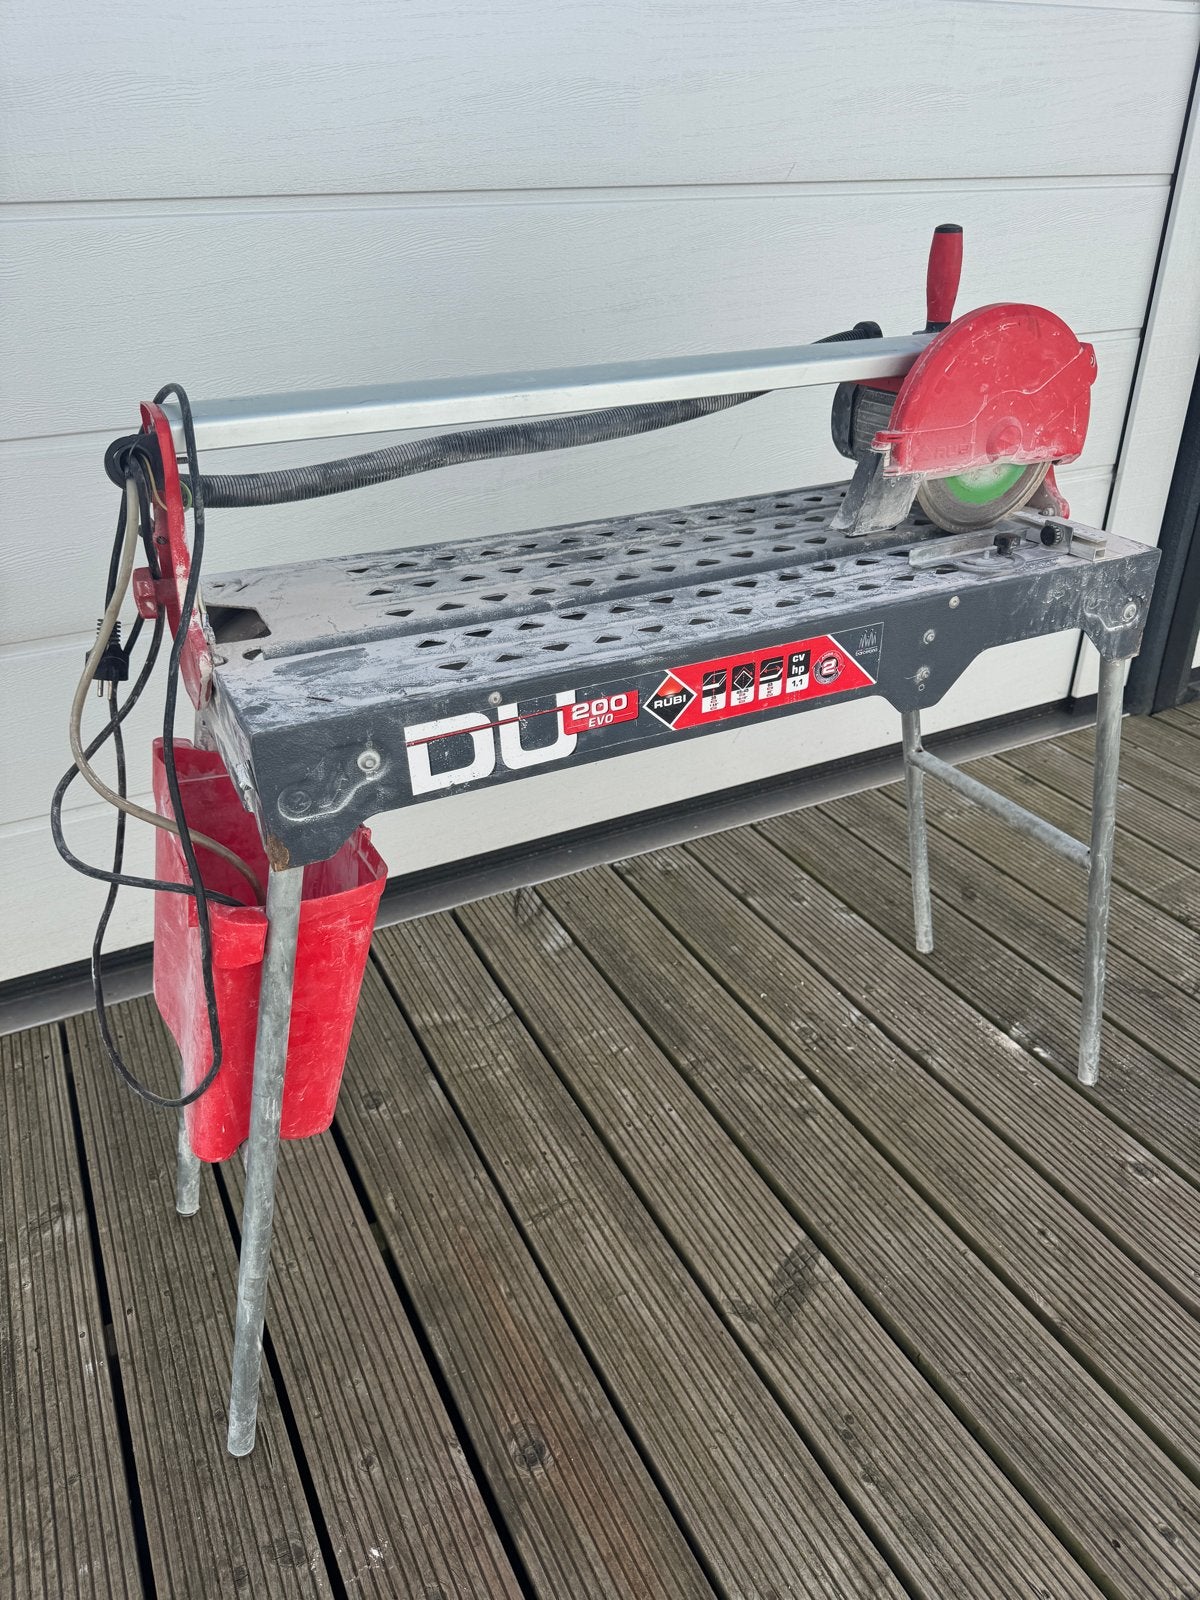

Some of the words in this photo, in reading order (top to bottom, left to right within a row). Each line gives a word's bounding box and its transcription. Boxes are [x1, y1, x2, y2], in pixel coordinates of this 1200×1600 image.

[792, 653, 806, 663] cv
[791, 665, 805, 676] hp
[791, 678, 803, 687] 1,1
[572, 694, 627, 721] 200
[653, 694, 687, 710] RUBI
[588, 713, 614, 728] EVO
[404, 690, 578, 795] DU
